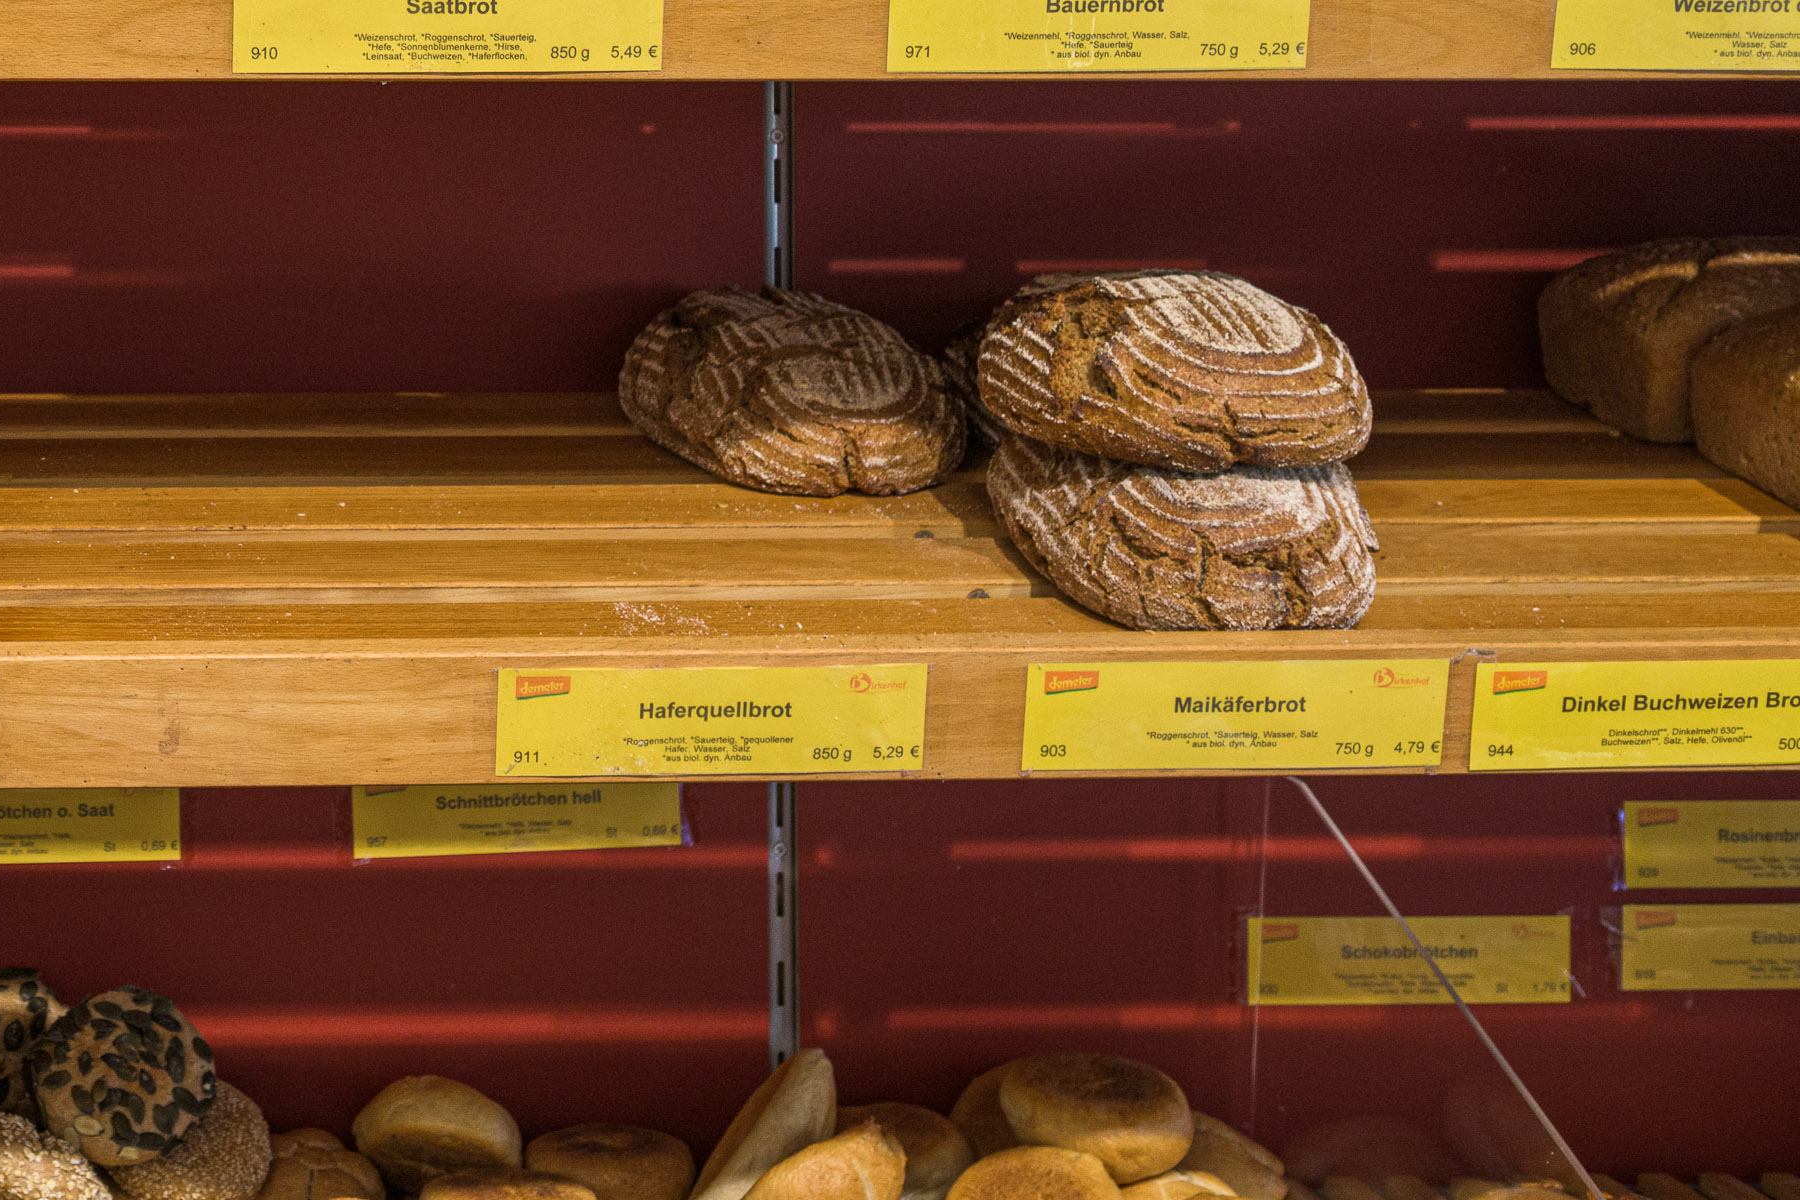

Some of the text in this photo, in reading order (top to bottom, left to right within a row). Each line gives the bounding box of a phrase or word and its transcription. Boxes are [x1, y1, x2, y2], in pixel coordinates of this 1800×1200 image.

[551, 46, 589, 61] 850 g
[611, 45, 658, 60] 5,49 €
[1201, 43, 1238, 59] 750 g
[1259, 42, 1305, 56] 5,29 €
[1174, 696, 1306, 713] Maikäferbrot
[1562, 695, 1626, 713] Dinkel
[1633, 693, 1758, 711] Buchweizen
[640, 701, 792, 722] Haferquellbrot
[813, 747, 852, 762] 850 g
[873, 745, 919, 760] 5,29 €
[1365, 745, 1373, 757] g
[1394, 741, 1440, 755] 4,79 €
[436, 789, 602, 810] Schnittbrötchen hell
[57, 807, 72, 818] o.
[77, 800, 115, 817] Saat
